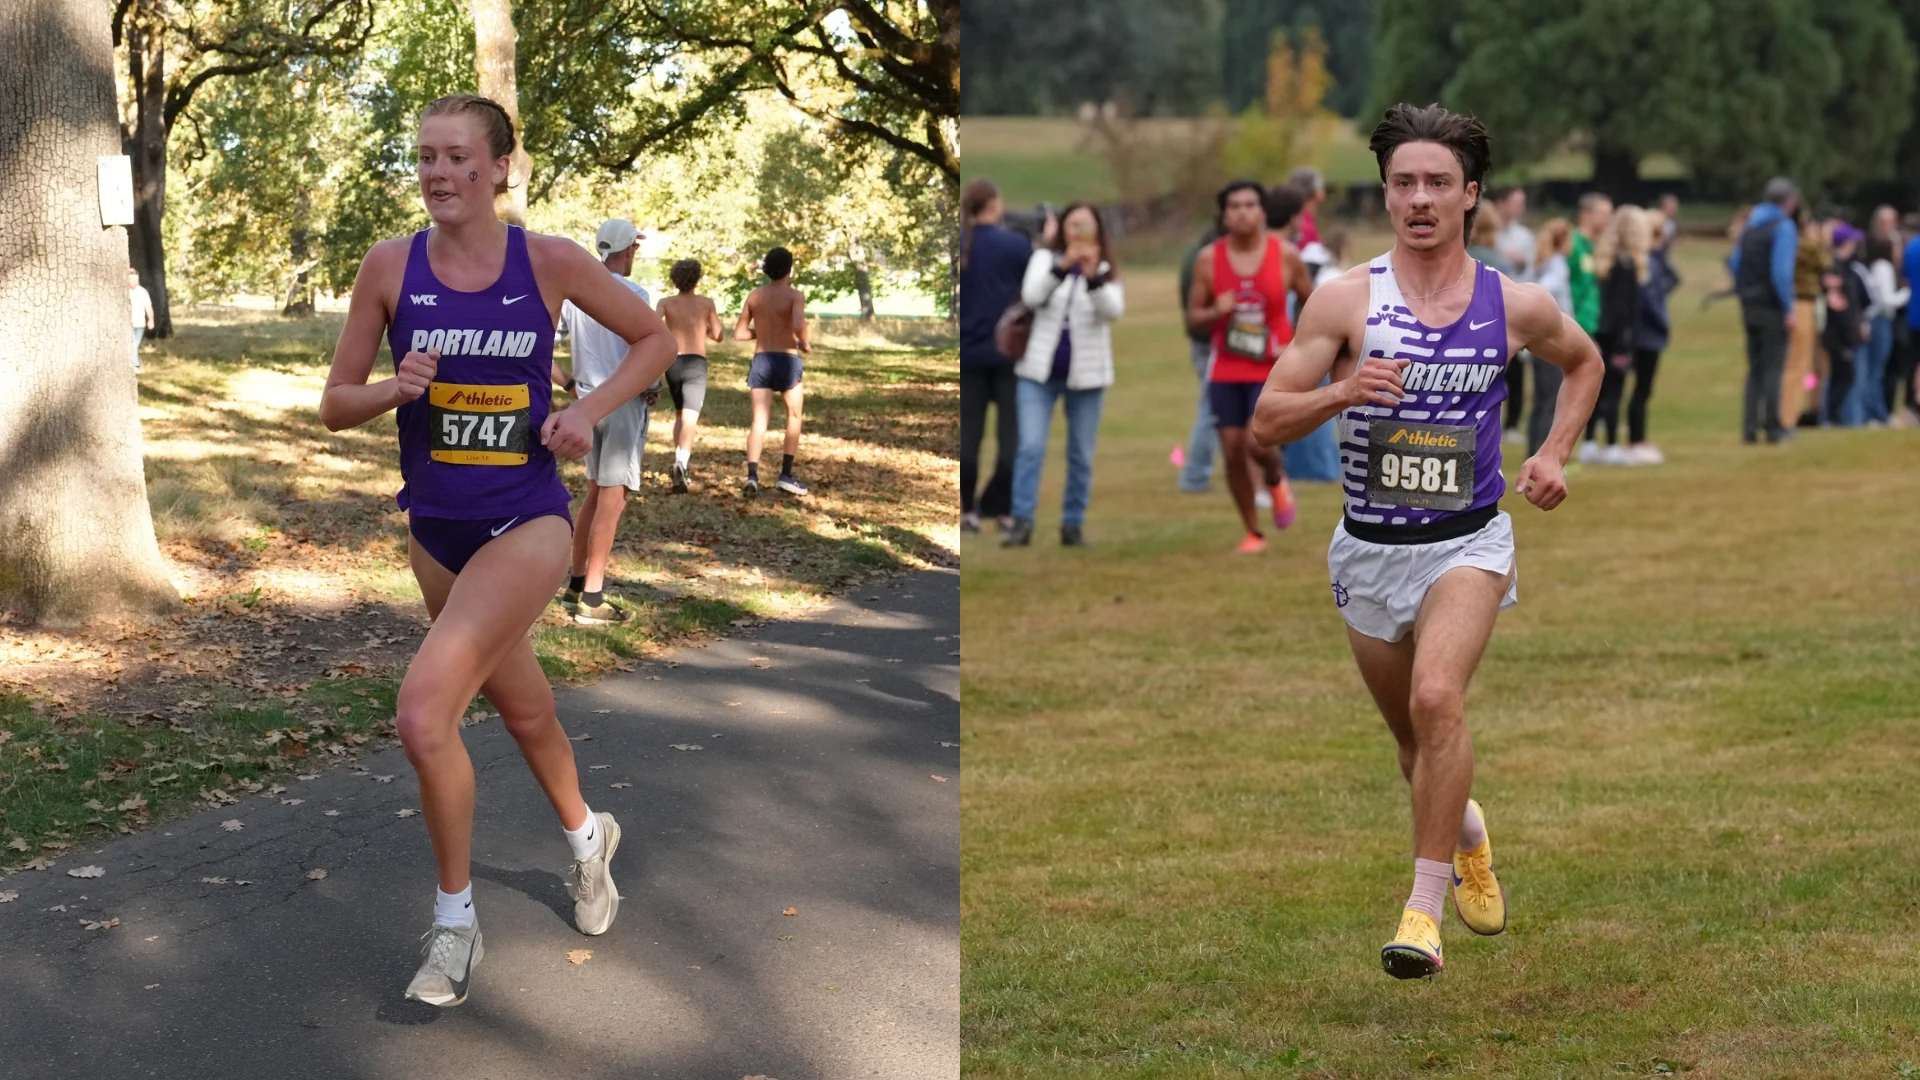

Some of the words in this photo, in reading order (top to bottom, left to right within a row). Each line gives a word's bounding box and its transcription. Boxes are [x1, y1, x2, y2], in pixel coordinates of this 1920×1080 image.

[411, 328, 537, 358] PORTLAND
[1401, 361, 1504, 393] RTLAND
[446, 390, 513, 406] Athletic
[442, 413, 516, 447] 5747
[1387, 428, 1458, 448] Athletic
[1381, 453, 1459, 493] 9581
